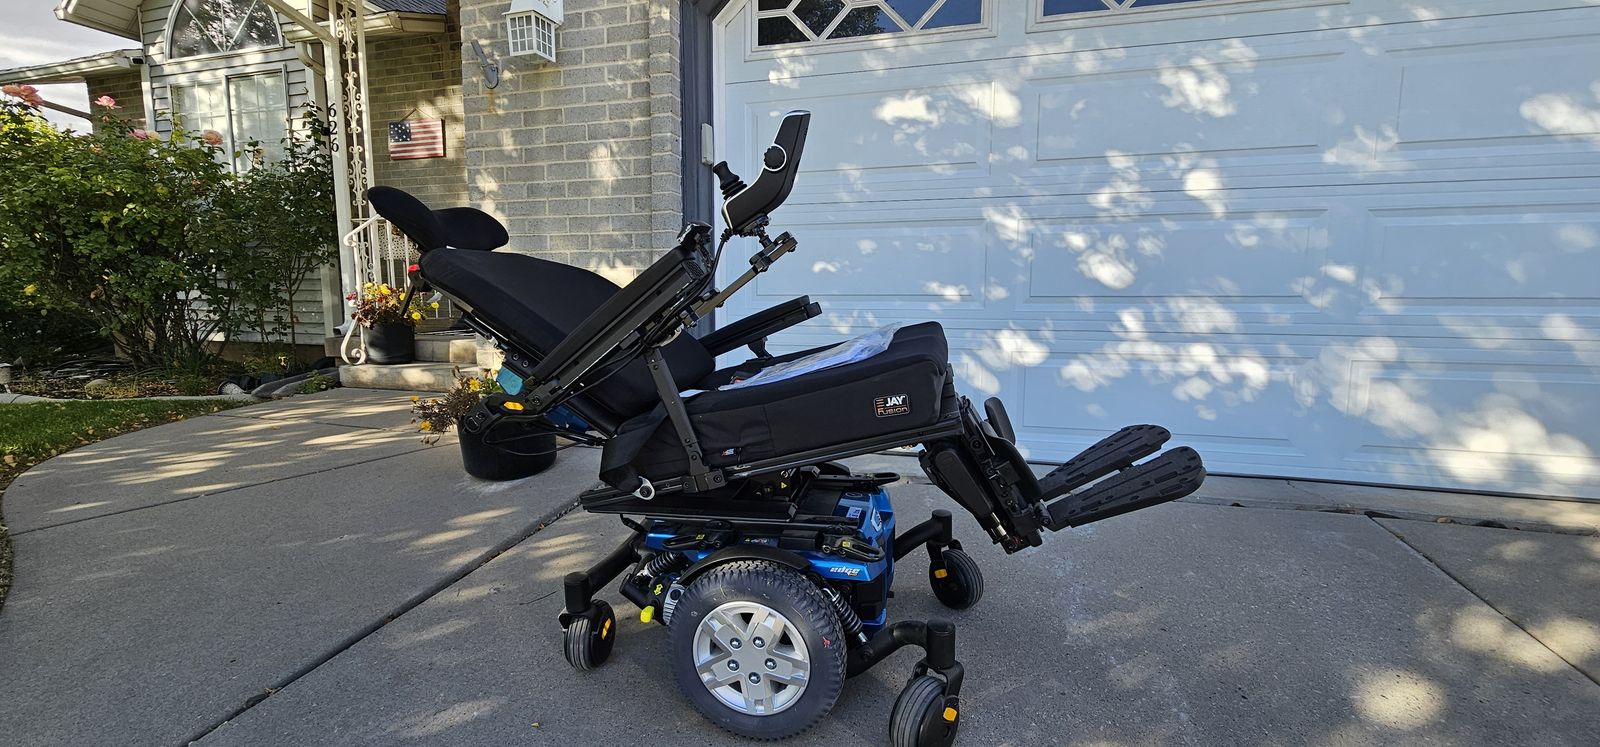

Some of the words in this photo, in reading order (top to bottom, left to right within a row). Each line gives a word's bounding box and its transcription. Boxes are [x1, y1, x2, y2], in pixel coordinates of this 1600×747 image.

[328, 103, 339, 152] 626
[886, 396, 905, 406] JAY
[830, 565, 861, 576] edge
